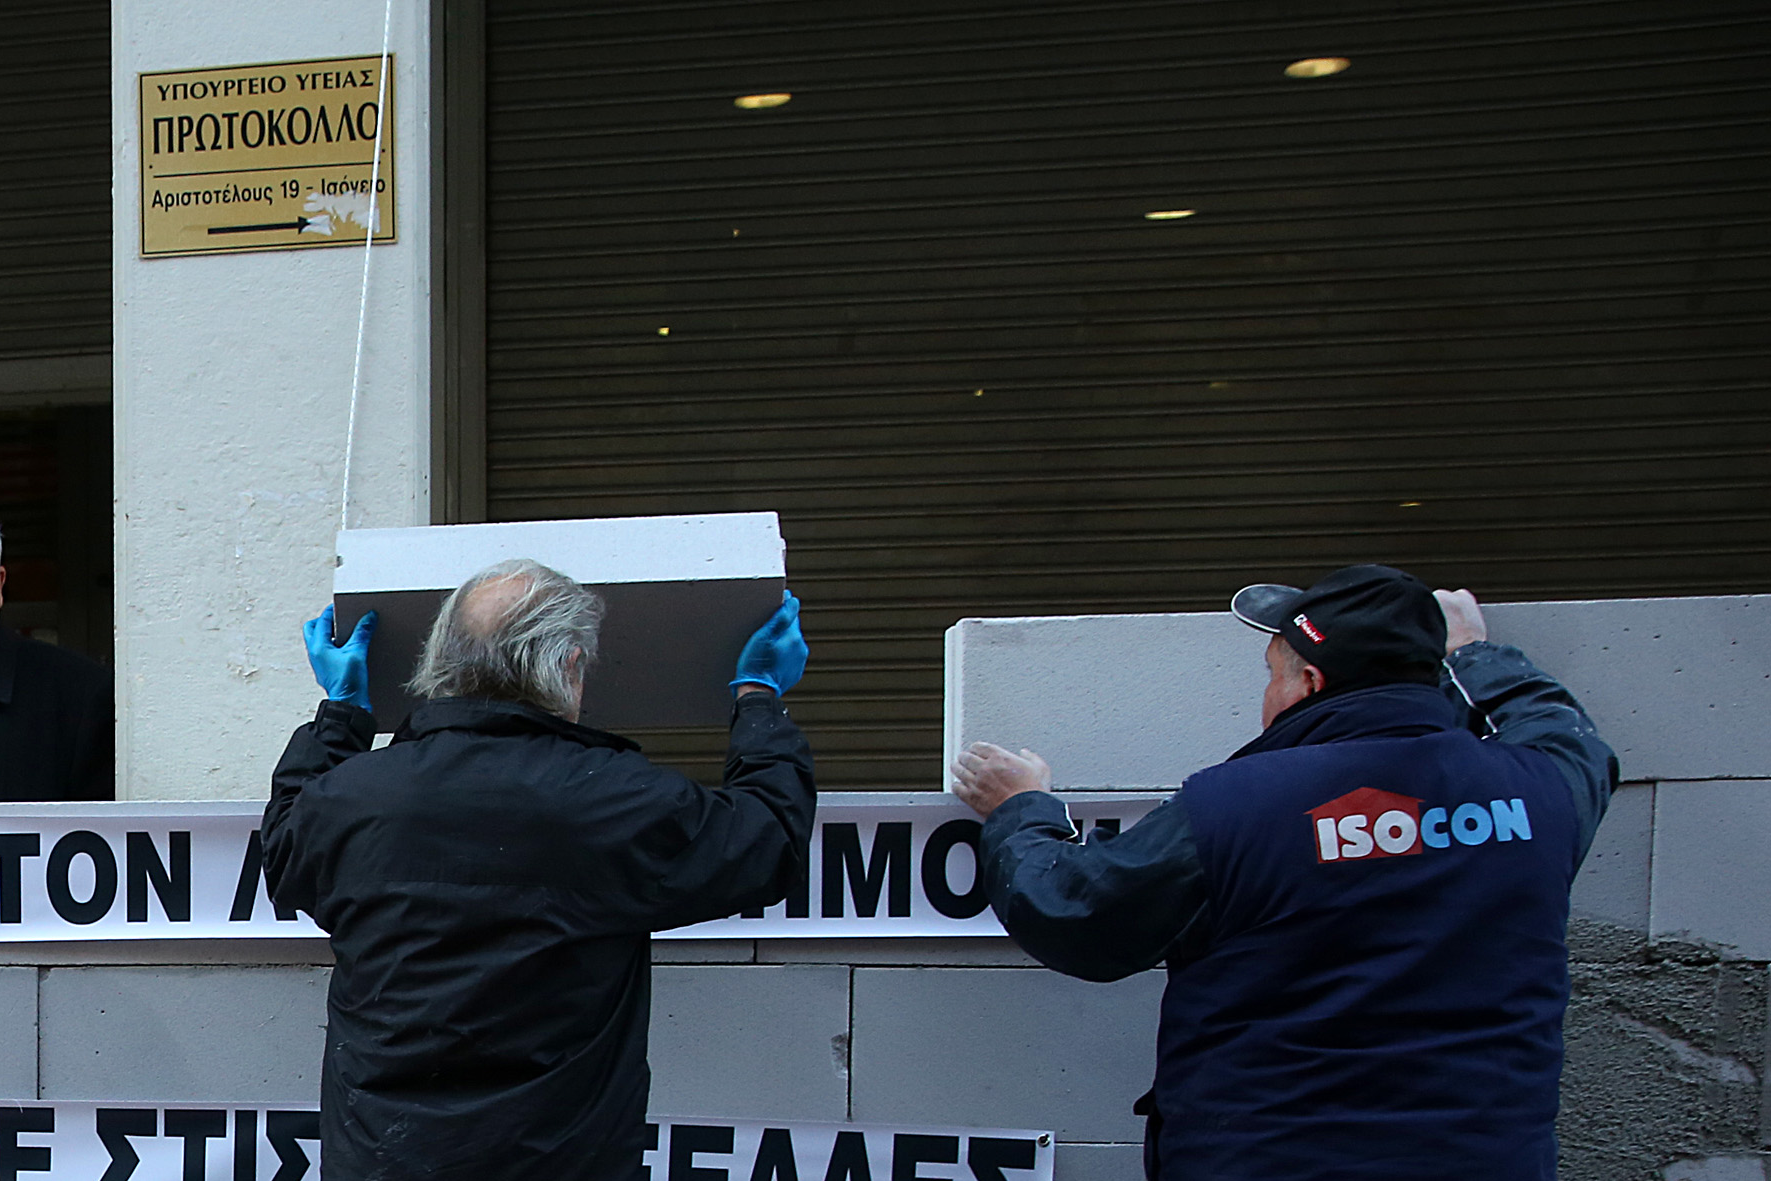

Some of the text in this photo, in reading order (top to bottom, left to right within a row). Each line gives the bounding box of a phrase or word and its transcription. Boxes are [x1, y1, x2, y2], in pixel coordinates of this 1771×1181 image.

[157, 69, 374, 101] ΥΠΟΥΡΓΕΙΟ ΥΓΕΙΑΣ
[153, 102, 379, 154] ΠΡΩΤΟΚΟΛΛΟ
[152, 183, 273, 212] Αριστοτέλους
[280, 179, 300, 199] 19
[1316, 798, 1532, 861] ISOCON
